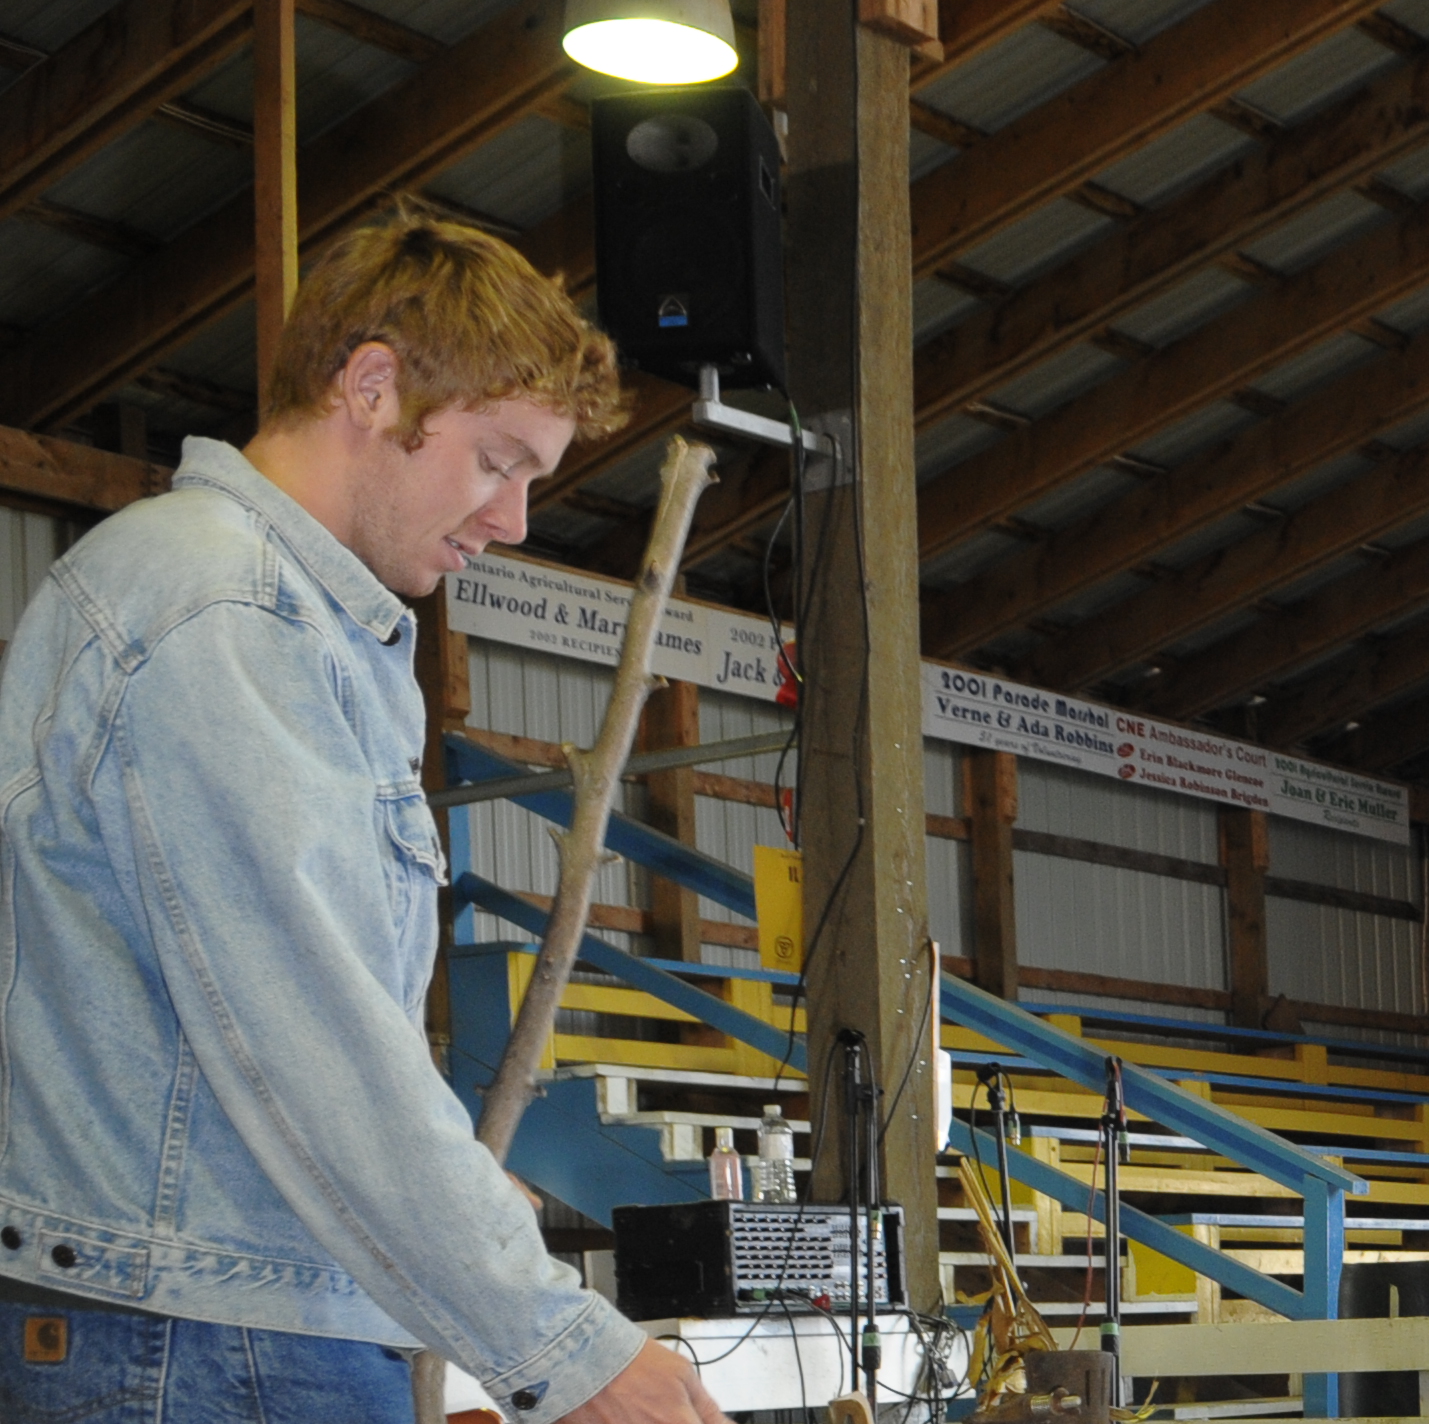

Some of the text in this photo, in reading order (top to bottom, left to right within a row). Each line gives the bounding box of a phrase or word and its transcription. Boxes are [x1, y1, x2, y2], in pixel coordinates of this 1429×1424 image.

[464, 556, 515, 580] Ontario
[518, 570, 602, 600] Agricultural
[664, 608, 694, 624] ward
[455, 578, 548, 620] Ellwood
[554, 603, 570, 626] &
[653, 630, 703, 656] ames
[730, 627, 766, 648] 2002
[716, 650, 767, 686] Jack
[941, 670, 1110, 729] 2001 Parade Marshal
[936, 695, 1114, 755] Verne & Ada Robbins
[1116, 717, 1267, 768] CNE Ambassador's Court
[1139, 767, 1269, 808] Jessica Robinson Brigden
[1140, 750, 1164, 766] Erin
[1166, 756, 1222, 780] Blackmore
[1280, 779, 1398, 821] Joan & Eric Muller
